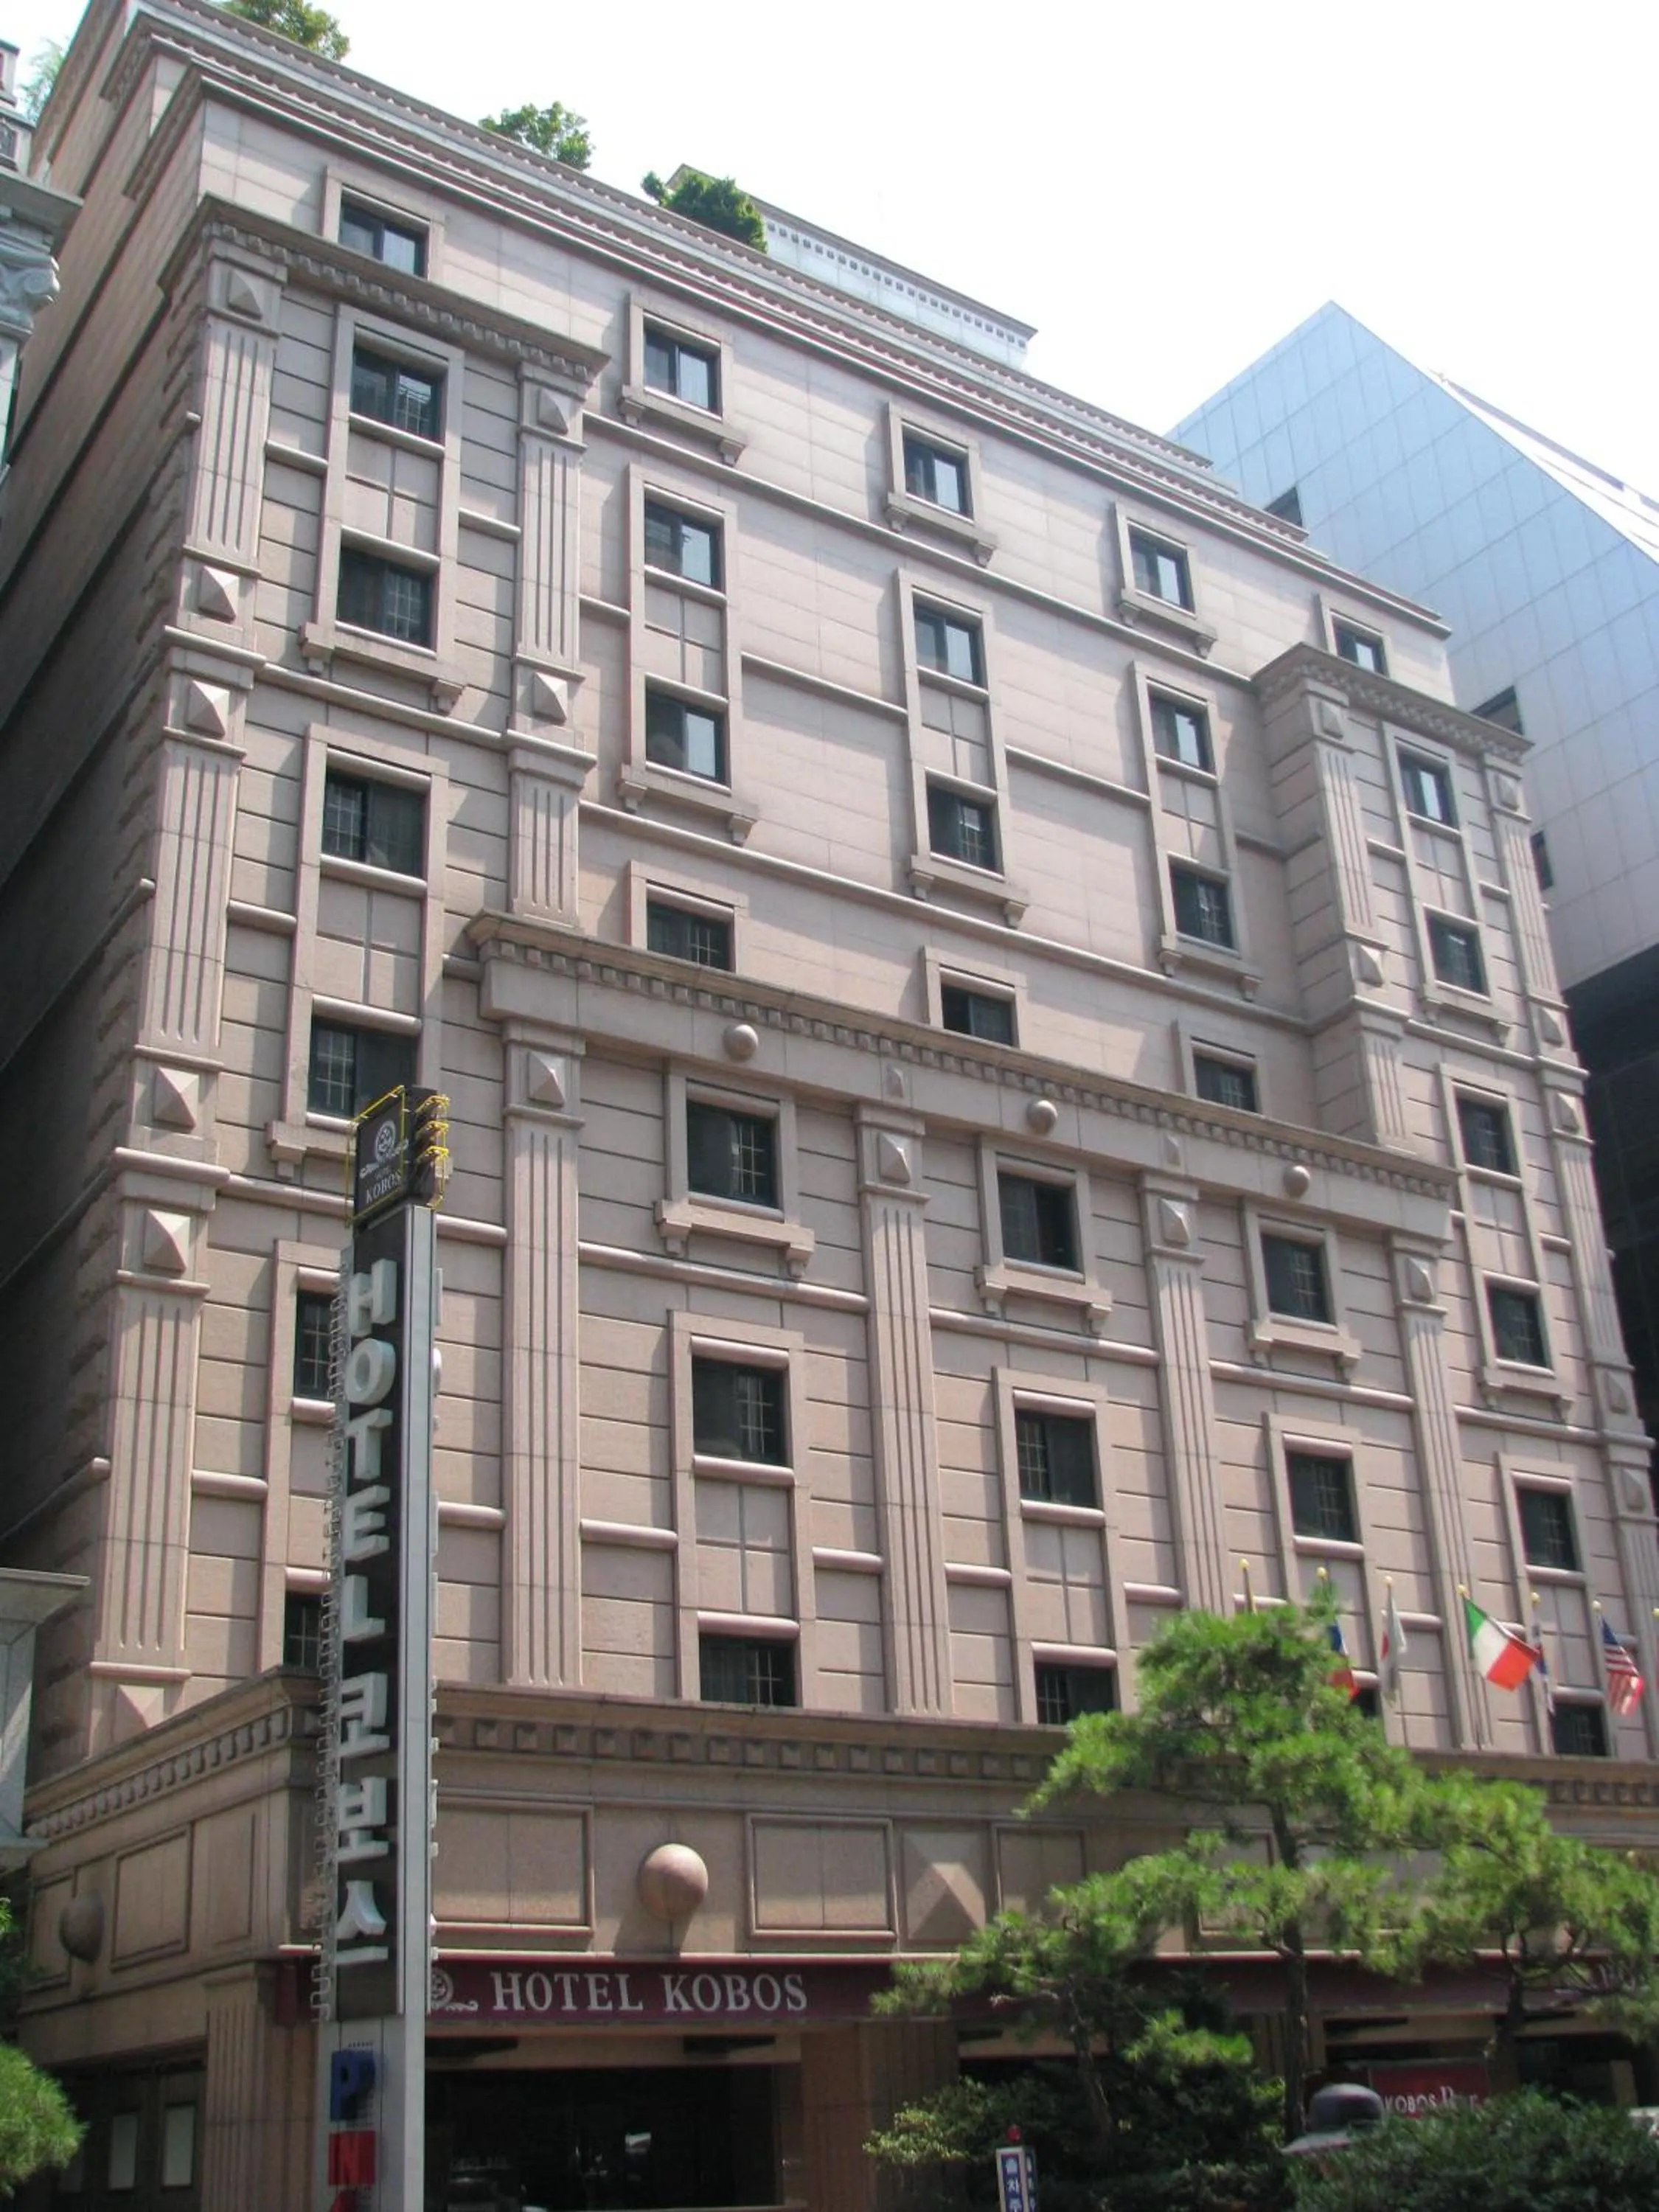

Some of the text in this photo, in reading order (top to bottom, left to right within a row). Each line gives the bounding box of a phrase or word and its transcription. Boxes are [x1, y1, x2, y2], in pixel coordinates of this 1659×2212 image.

[344, 1259, 397, 1642] HOTEL
[335, 1672, 390, 1965] 코보스
[490, 1971, 807, 2012] HOTEL KOBOS
